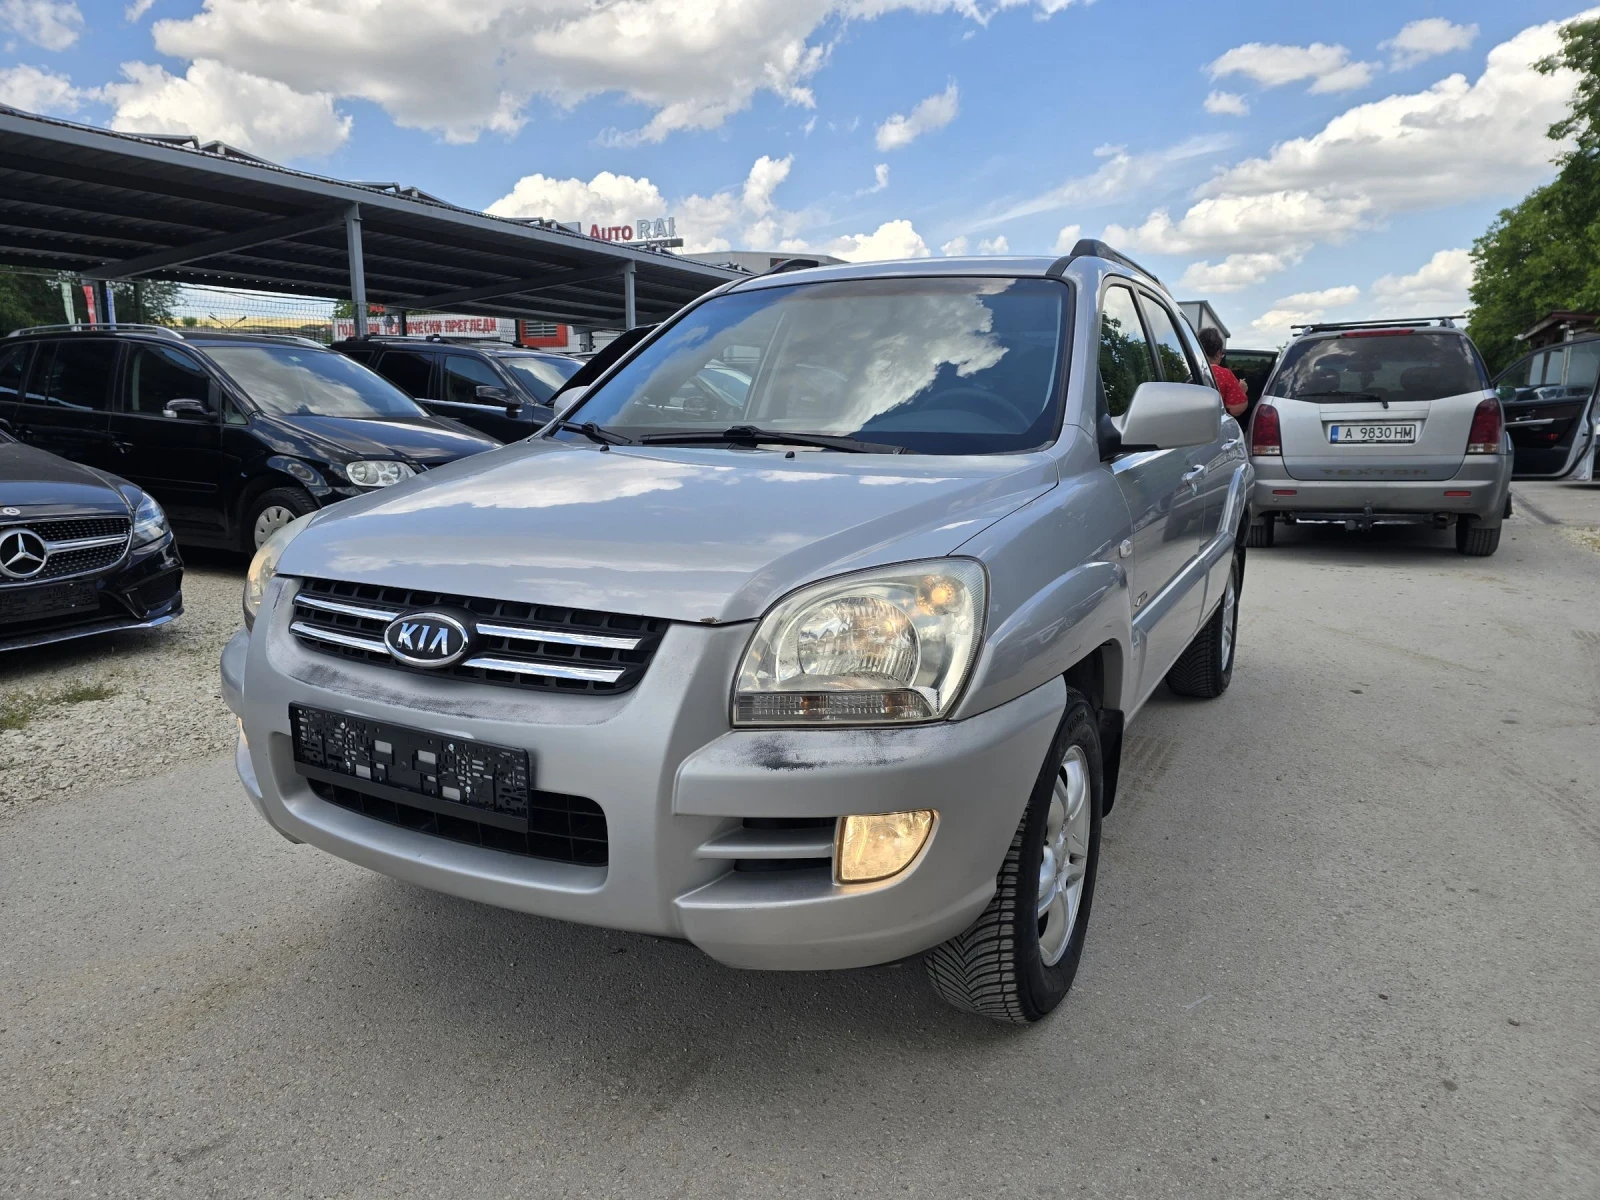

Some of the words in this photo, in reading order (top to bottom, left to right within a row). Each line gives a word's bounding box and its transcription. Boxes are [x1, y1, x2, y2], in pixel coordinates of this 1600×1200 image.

[590, 224, 633, 241] AUTO
[337, 323, 380, 336] ГОДНИ
[445, 317, 497, 334] ПРЕГЛЕДИ
[1345, 428, 1352, 439] A
[1360, 427, 1392, 439] 9830
[1394, 427, 1412, 439] HM
[396, 622, 448, 655] KIA
